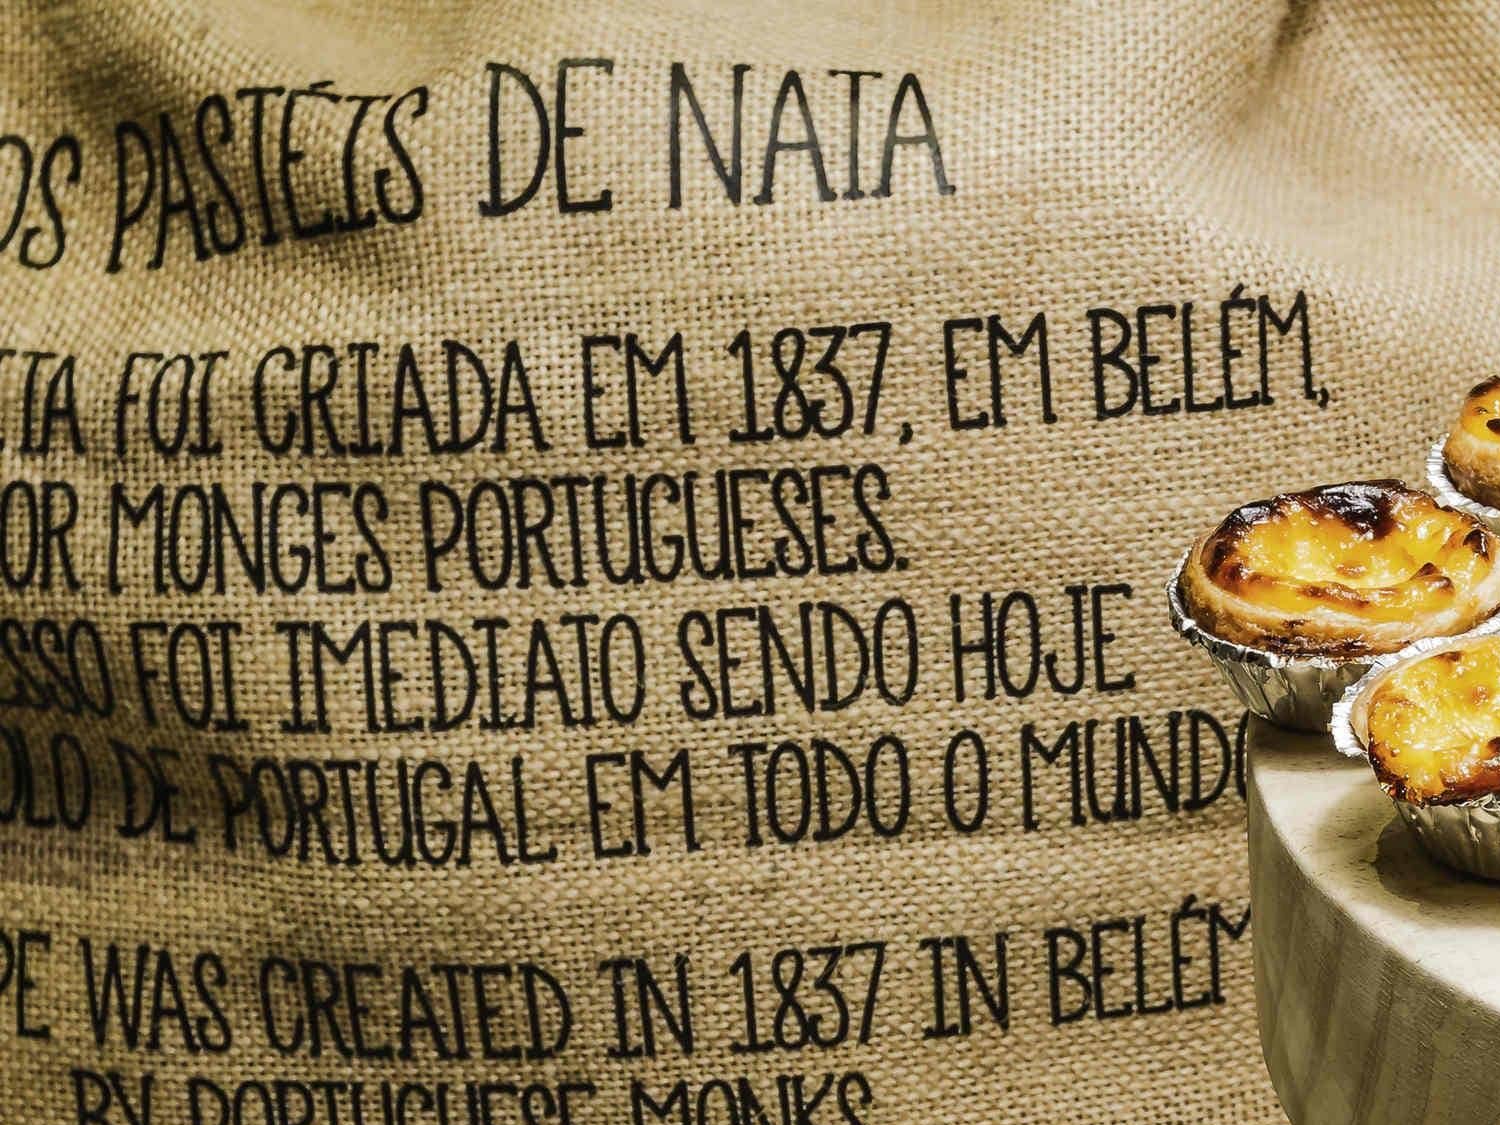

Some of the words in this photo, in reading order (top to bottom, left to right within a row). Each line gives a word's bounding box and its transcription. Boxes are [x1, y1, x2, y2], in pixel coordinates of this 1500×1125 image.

[105, 80, 428, 273] PASTÉIS
[479, 58, 612, 216] DE
[669, 61, 955, 209] NATA
[0, 350, 85, 452] TA
[116, 351, 228, 460] FOI
[253, 340, 549, 456] CRIADA
[581, 332, 696, 450] EM
[728, 320, 913, 446] 1837,
[943, 312, 1057, 431] EM
[1088, 284, 1328, 420] BELÉM,
[109, 481, 394, 597] MONGES
[420, 464, 909, 592] PORTUGUESES.
[130, 622, 247, 733] FOI
[276, 612, 646, 734] IMEDIATO
[678, 597, 918, 720] SENDO
[950, 583, 1136, 703] HOJE
[110, 737, 197, 844] DE
[208, 756, 558, 868] PORTUGAL
[586, 748, 700, 860] EM
[728, 734, 911, 848] TODO
[943, 729, 989, 833] O
[80, 936, 232, 1055] WAS
[259, 957, 573, 1060] CREATED
[600, 951, 694, 1060] IN
[730, 940, 887, 1053] 1837
[921, 933, 1009, 1040] IN
